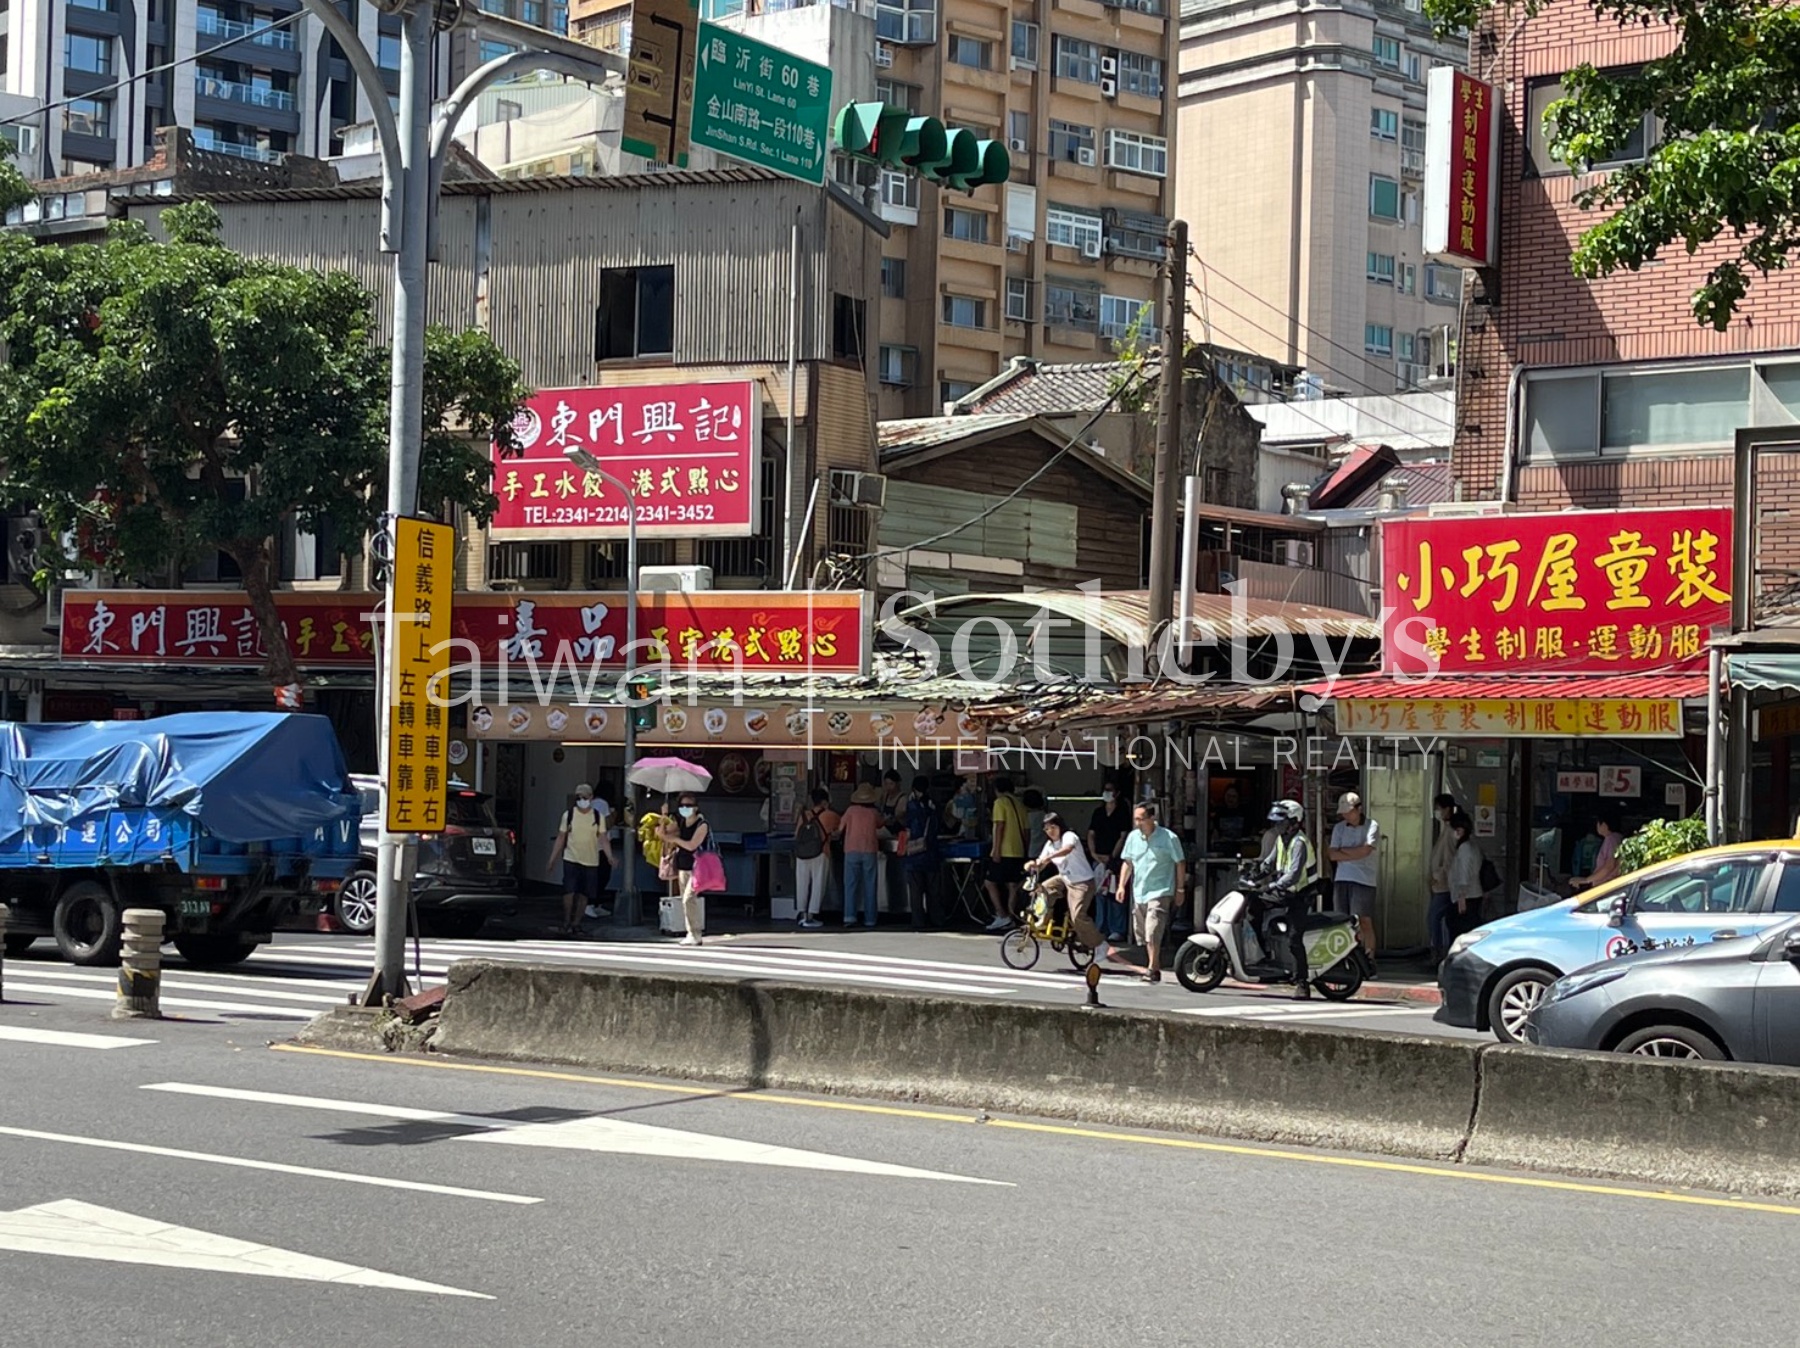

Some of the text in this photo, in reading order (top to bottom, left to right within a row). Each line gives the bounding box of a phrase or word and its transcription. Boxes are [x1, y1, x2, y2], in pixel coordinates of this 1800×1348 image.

[706, 93, 816, 150] 金山南路一段110巷
[733, 77, 754, 94] LinYi
[767, 90, 785, 105] Lane
[786, 97, 797, 110] 60
[705, 125, 738, 144] JinShan
[781, 149, 800, 165] Lane
[545, 397, 739, 446] 東門興記
[502, 465, 740, 502] 手工水餃 港式點心
[523, 503, 714, 524] TEL:2341-2214 2341-3452
[412, 527, 435, 664] 信義路上
[1396, 528, 1733, 613] 小巧屋童裝
[500, 598, 838, 664] 嘉品 正宗港式點心
[395, 669, 417, 824] 左轉車靠左
[422, 670, 443, 825] 右轉車靠右
